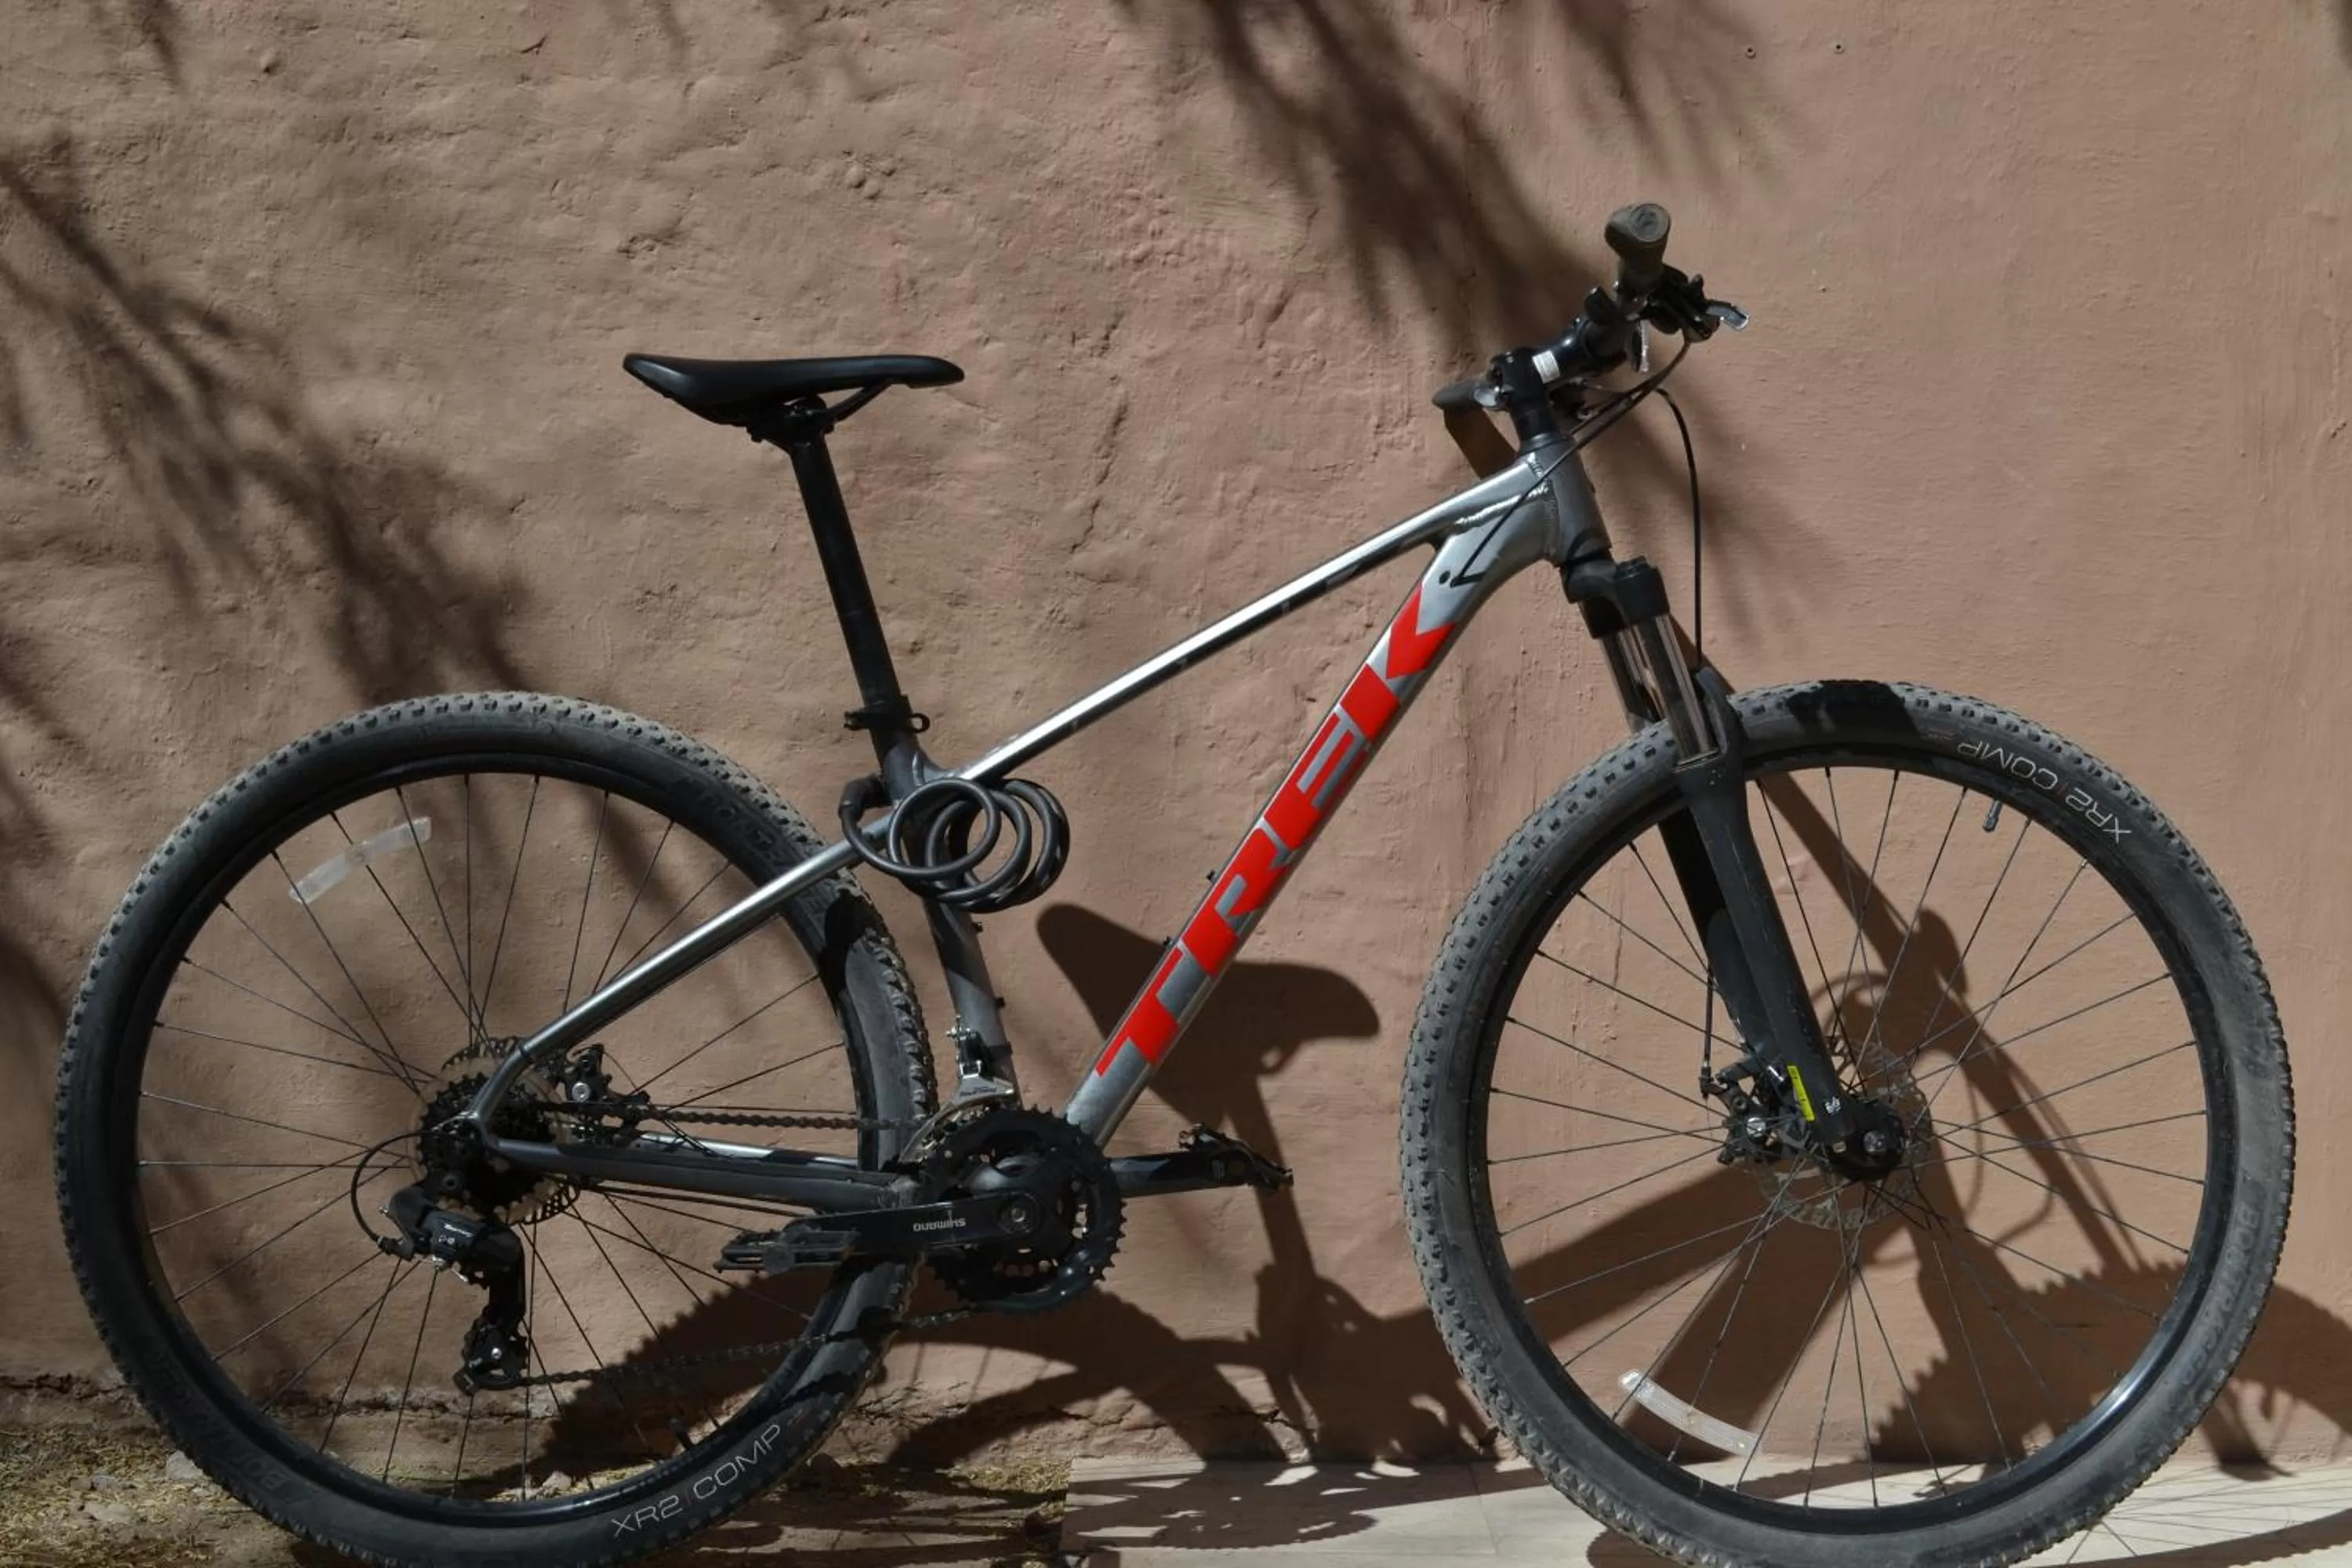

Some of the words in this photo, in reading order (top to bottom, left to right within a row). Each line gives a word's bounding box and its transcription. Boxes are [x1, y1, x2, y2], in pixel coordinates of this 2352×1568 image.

[1956, 740, 2059, 790] COMP
[1096, 588, 1456, 1076] TREK
[2064, 786, 2132, 844] XR2
[611, 1494, 684, 1538] XR2
[692, 1423, 782, 1501] COMP
